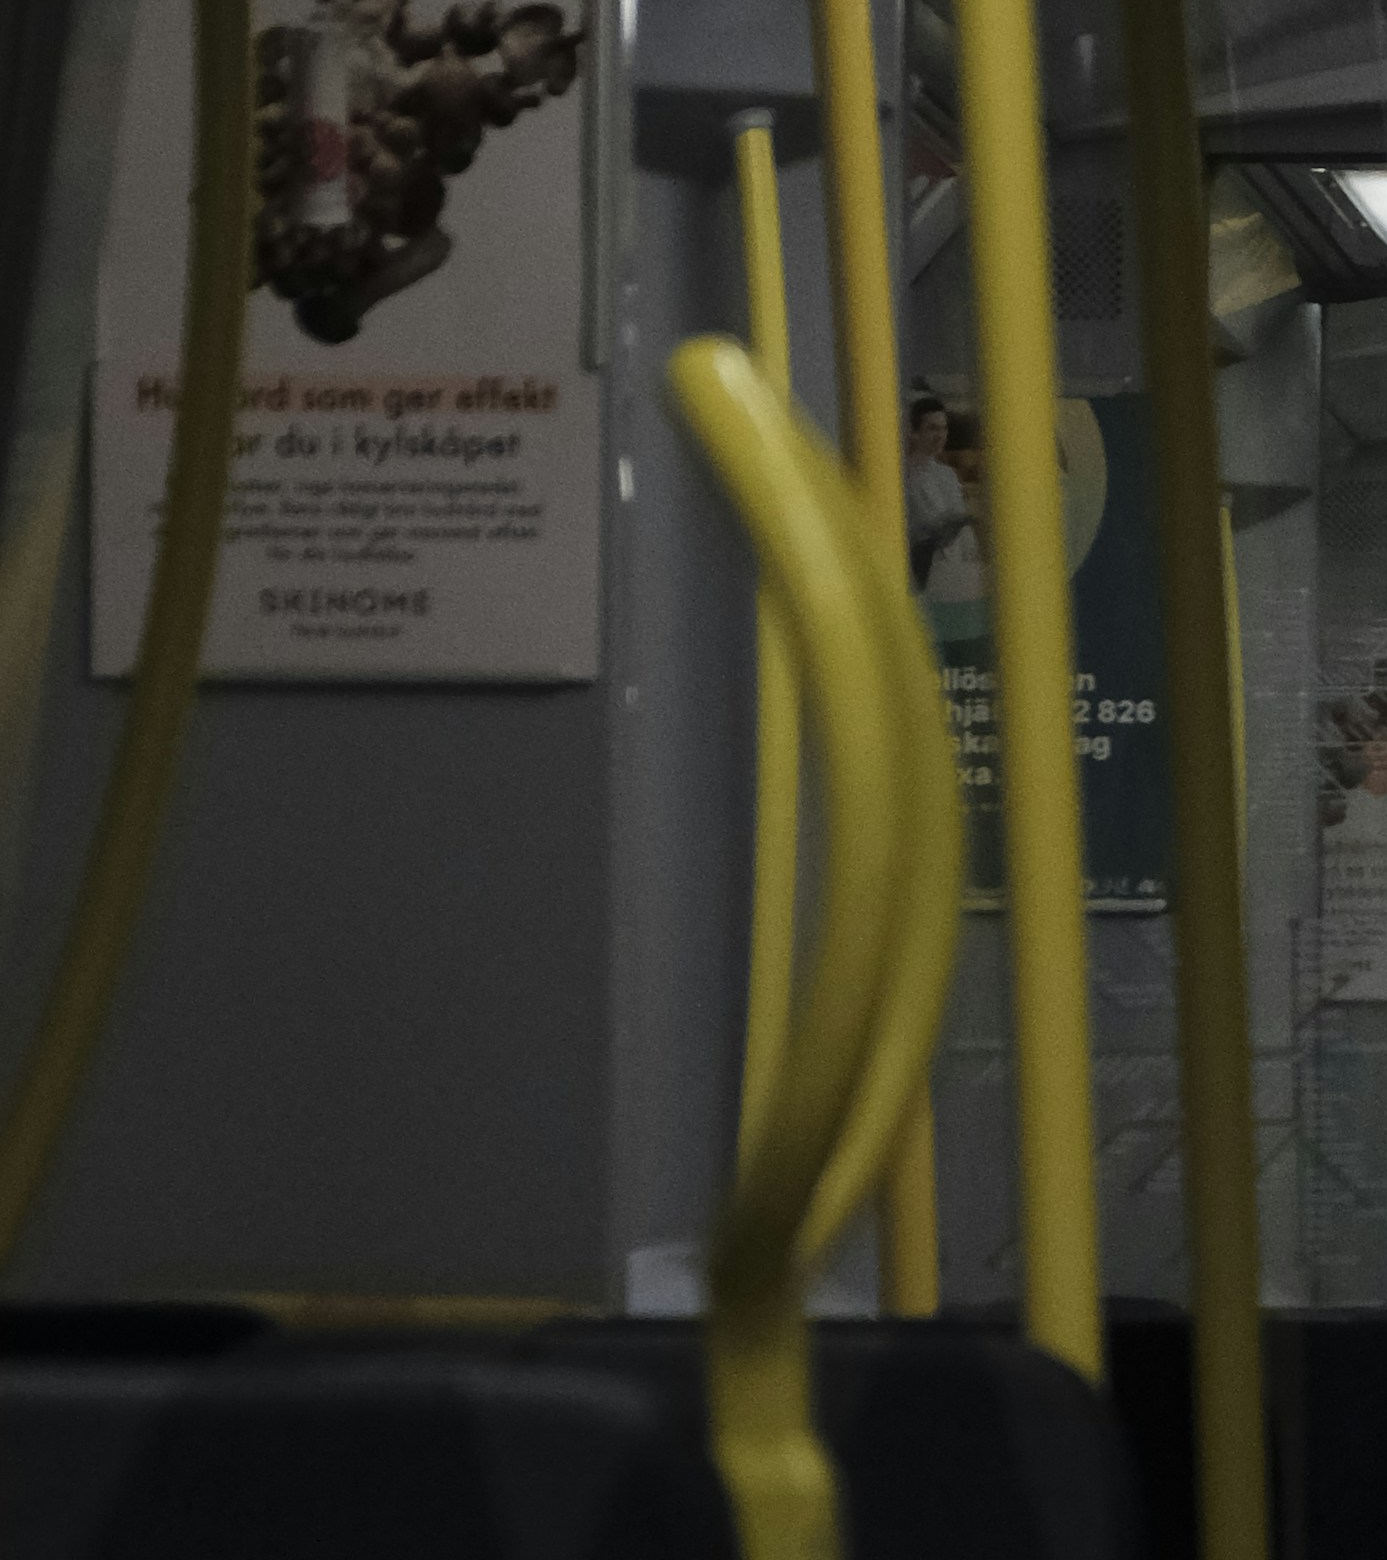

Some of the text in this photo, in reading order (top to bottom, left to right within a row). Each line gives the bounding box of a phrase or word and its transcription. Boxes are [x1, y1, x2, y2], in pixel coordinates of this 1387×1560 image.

[302, 388, 371, 412] som
[383, 388, 443, 420] ger
[455, 375, 559, 411] effekt
[275, 423, 321, 457] du
[331, 425, 341, 456] i
[1096, 699, 1157, 724] 826
